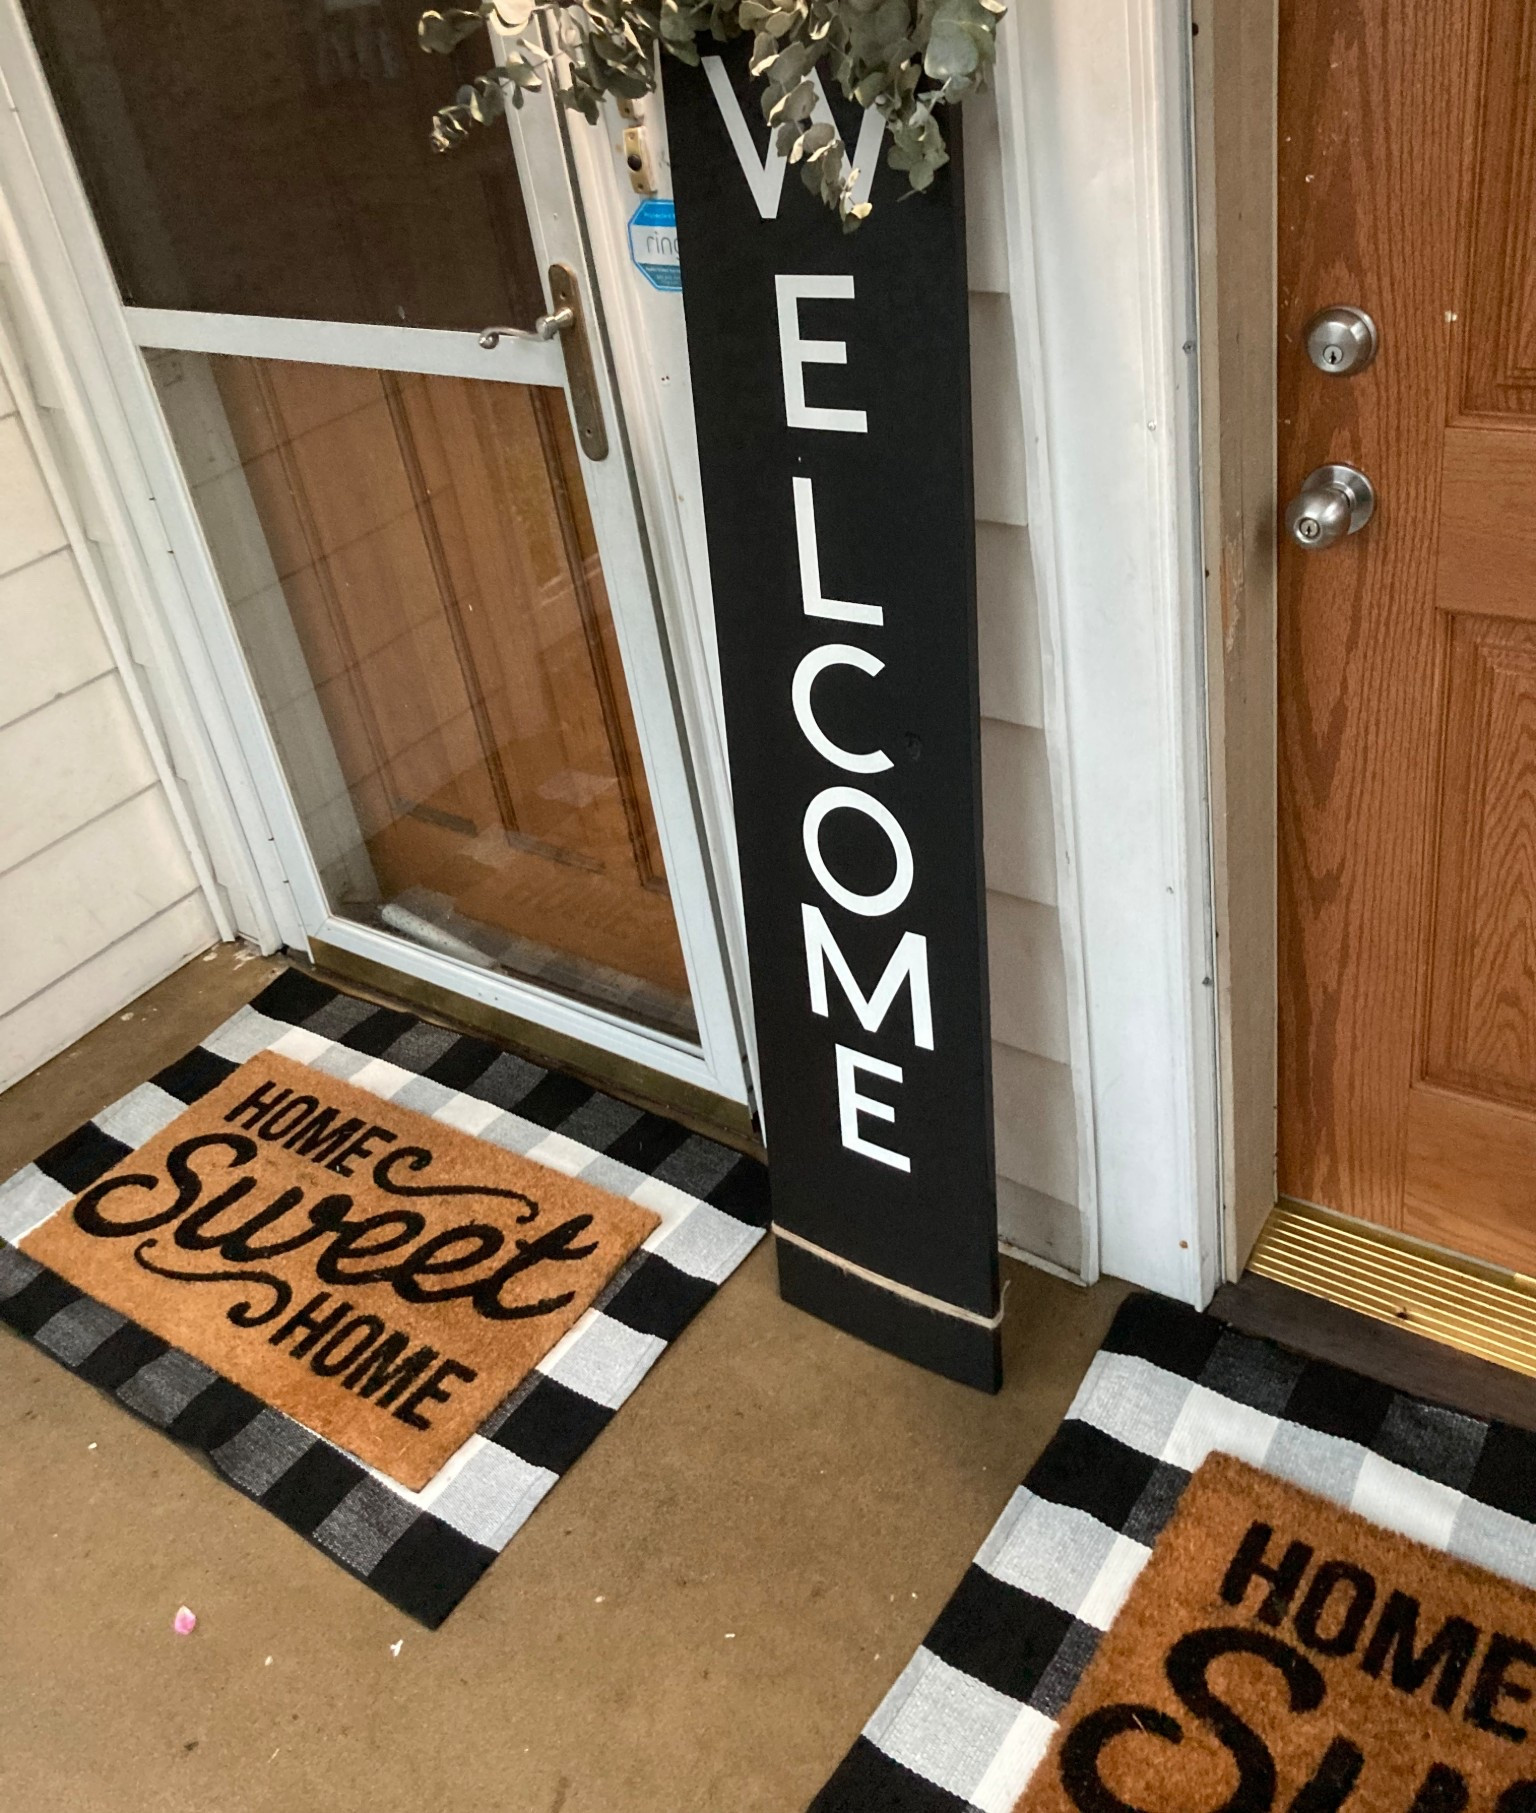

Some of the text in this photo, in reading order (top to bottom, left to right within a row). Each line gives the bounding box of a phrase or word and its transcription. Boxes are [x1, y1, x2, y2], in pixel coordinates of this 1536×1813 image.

[701, 55, 934, 1173] WELCOME
[225, 1081, 398, 1178] HOME
[73, 1132, 599, 1321] Sweet
[268, 1292, 478, 1431] HOME
[1219, 1520, 1536, 1742] HOME
